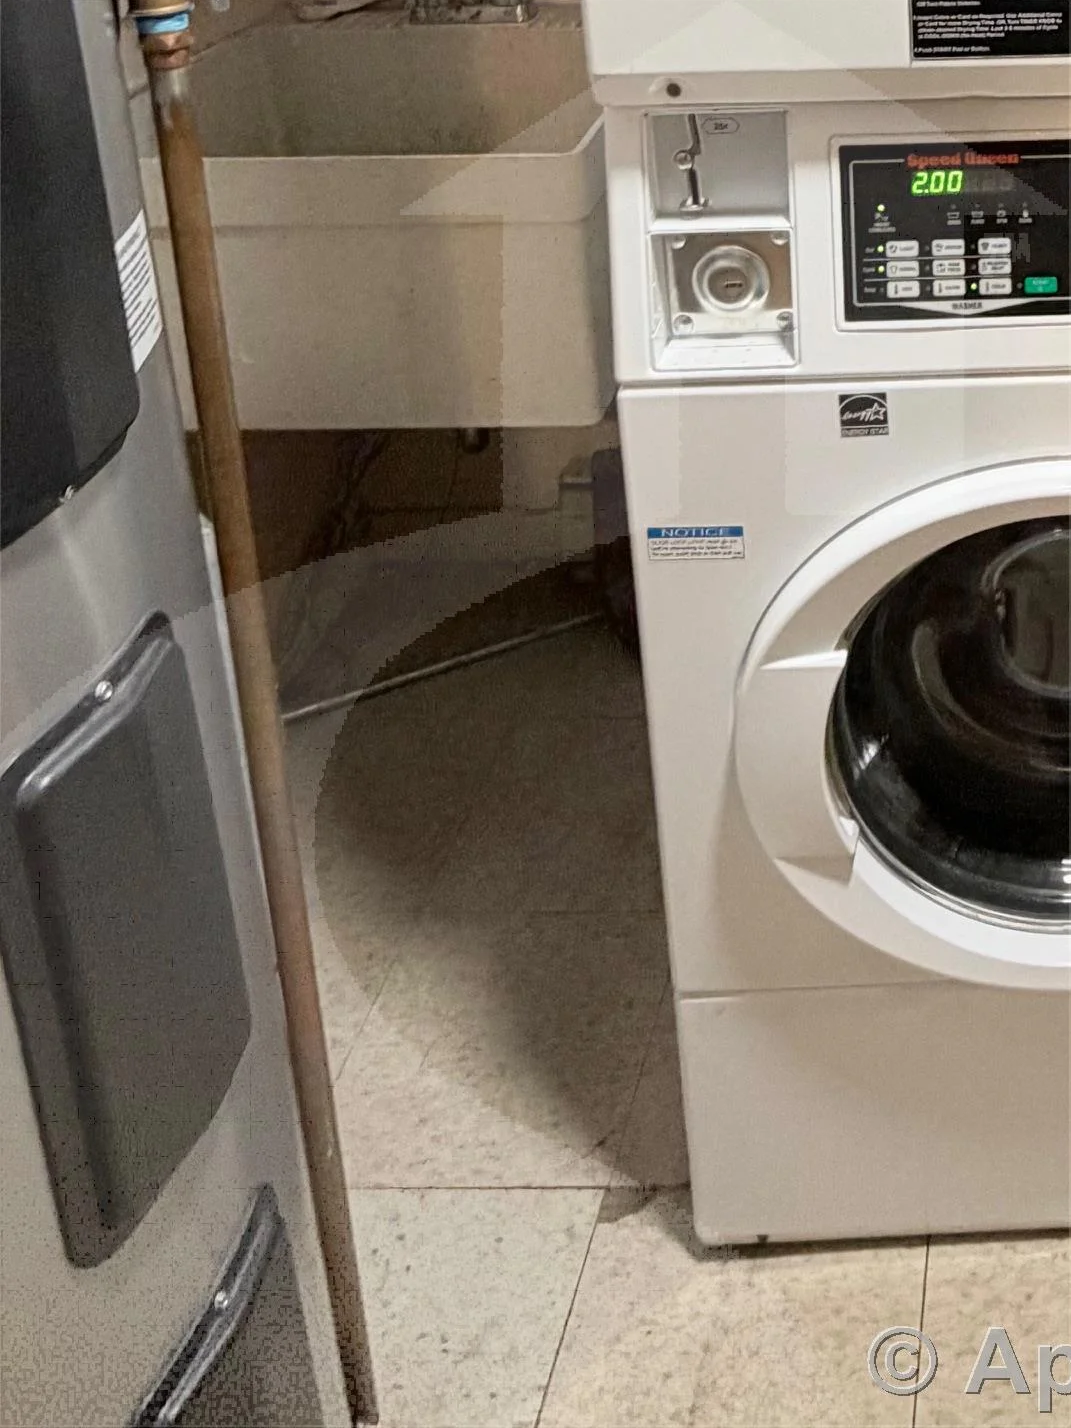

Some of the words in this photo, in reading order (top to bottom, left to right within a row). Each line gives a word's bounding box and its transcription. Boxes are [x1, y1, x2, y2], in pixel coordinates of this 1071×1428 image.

[907, 153, 962, 169] Speed
[965, 152, 1019, 165] Queen
[912, 170, 963, 196] 2.00
[662, 528, 724, 537] NOTICE
